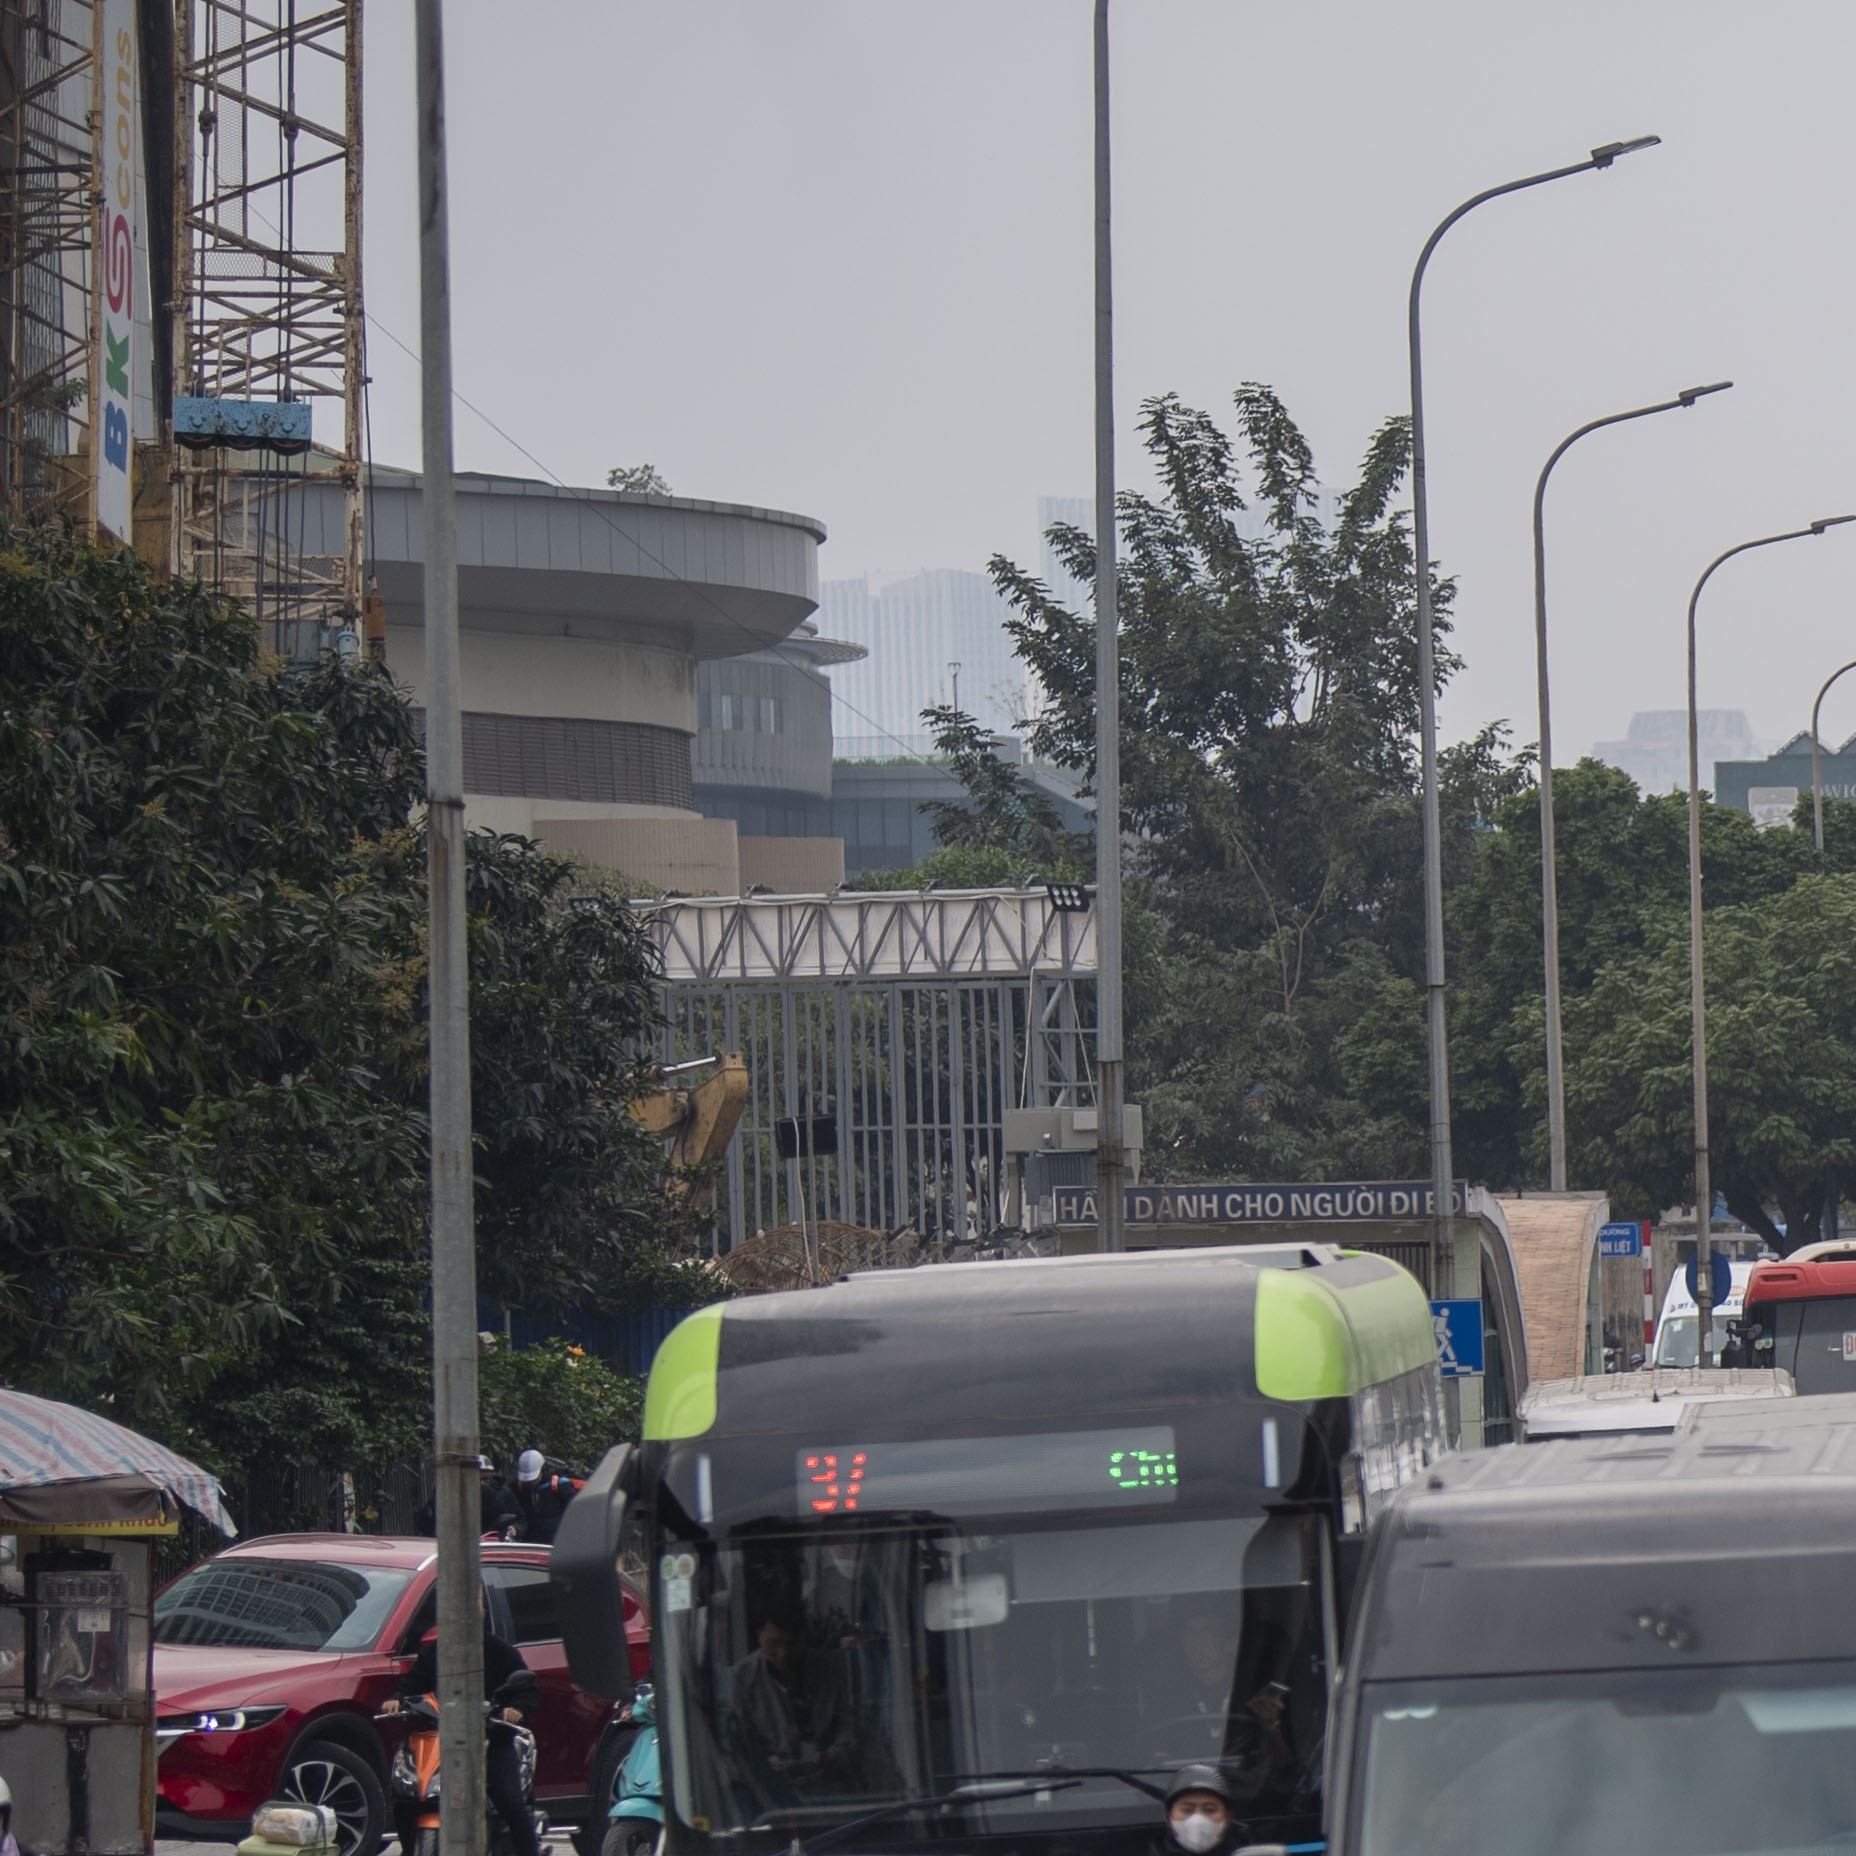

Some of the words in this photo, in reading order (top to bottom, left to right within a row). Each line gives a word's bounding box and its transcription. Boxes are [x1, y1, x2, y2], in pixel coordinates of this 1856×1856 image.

[1135, 1188, 1218, 1218] DÀNH
[1225, 1193, 1283, 1218] CHO
[1291, 1188, 1384, 1217] NGƯỜI
[1389, 1191, 1418, 1216] ĐI
